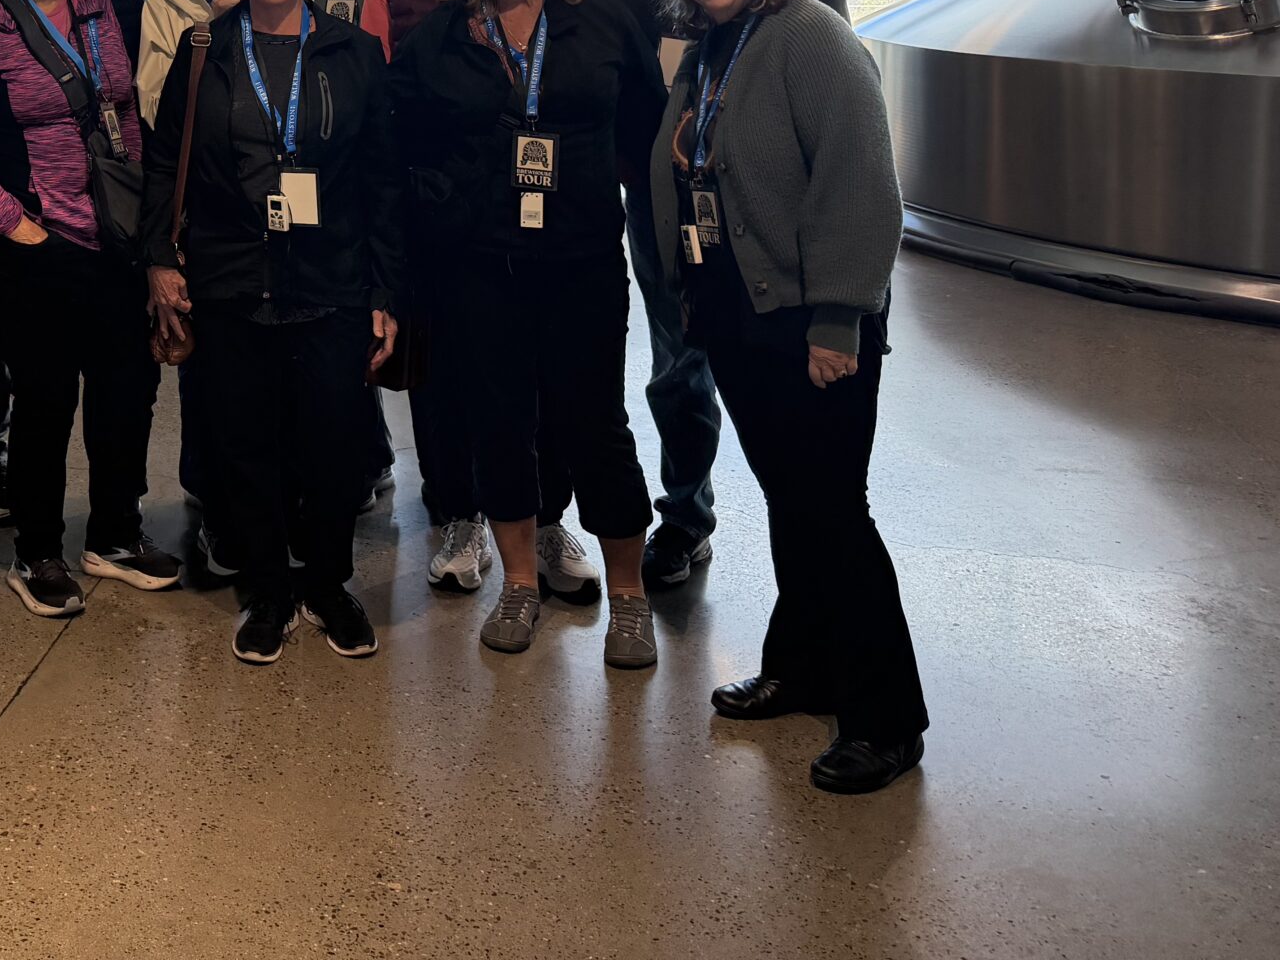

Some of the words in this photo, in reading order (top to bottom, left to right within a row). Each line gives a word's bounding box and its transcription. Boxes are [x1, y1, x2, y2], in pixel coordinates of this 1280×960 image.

[529, 59, 541, 95] FIRESTONE
[536, 27, 546, 55] WALKER
[290, 71, 300, 101] WALKER
[285, 105, 298, 145] FIRESTONE
[516, 173, 552, 187] TOUR
